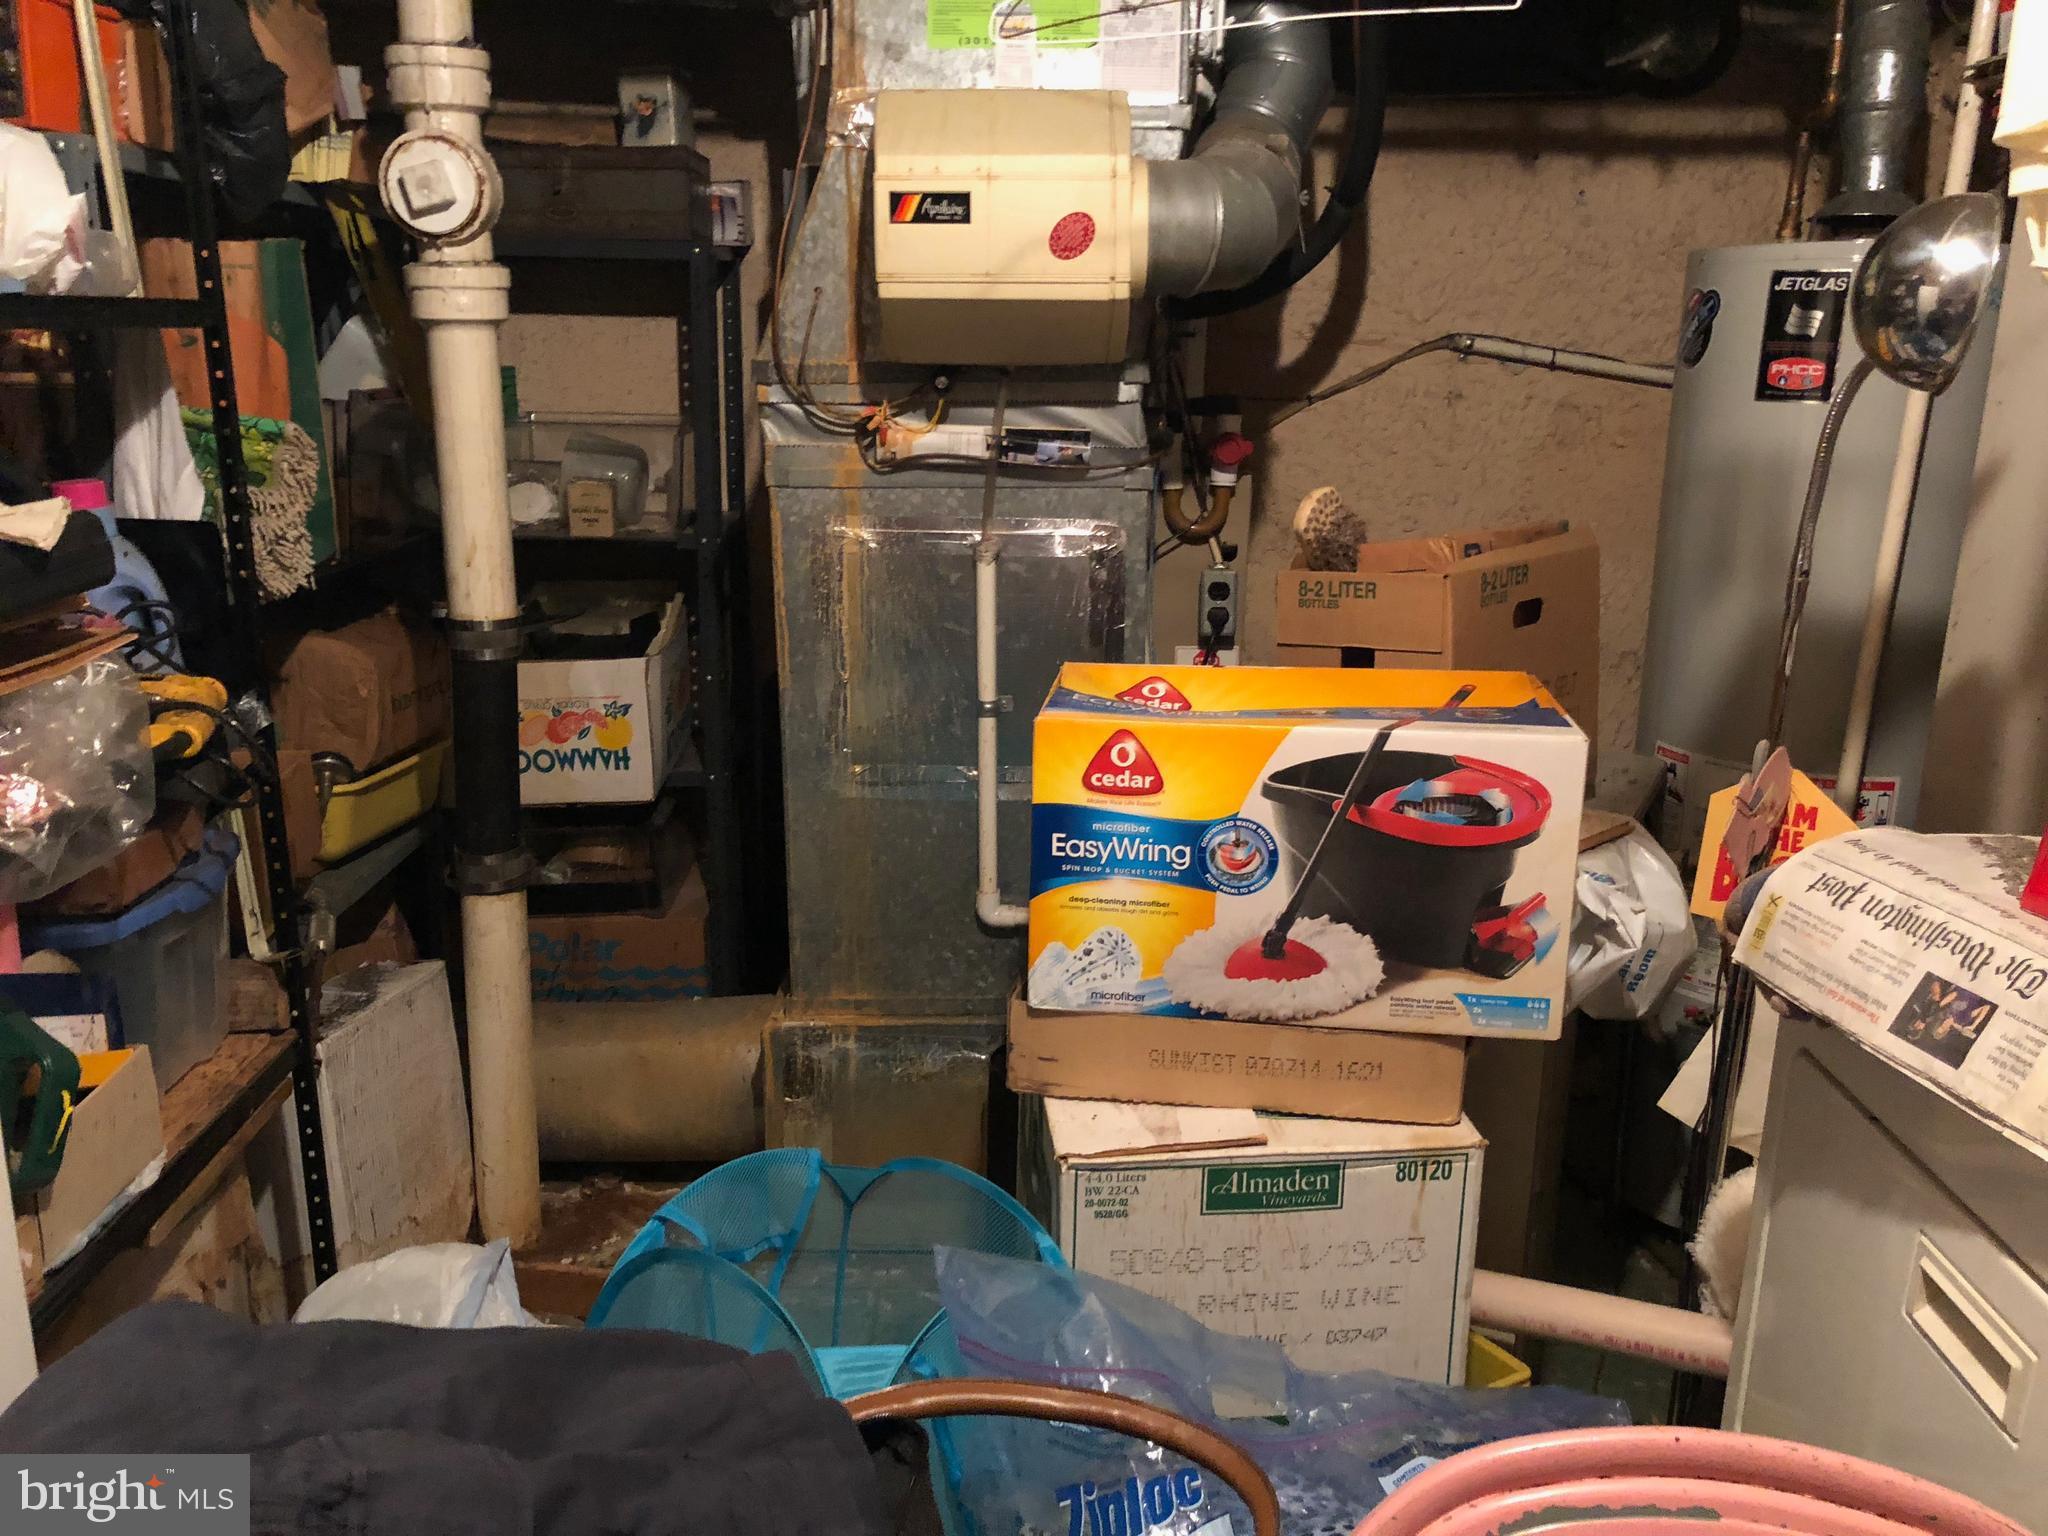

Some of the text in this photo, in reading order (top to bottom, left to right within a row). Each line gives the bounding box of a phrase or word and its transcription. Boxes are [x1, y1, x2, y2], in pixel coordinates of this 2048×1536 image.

[1774, 277, 1848, 292] JETGLAS
[1772, 364, 1825, 376] PHCC
[1480, 563, 1530, 594] 8-2 LITER
[1298, 580, 1377, 599] 8-2 LITER
[1297, 597, 1340, 609] BOTTLES
[1122, 695, 1184, 711] cedar
[1110, 742, 1137, 767] O
[1090, 769, 1155, 789] cedar
[1092, 822, 1151, 833] microfiber
[1200, 820, 1235, 848] CONTROLLED
[1235, 820, 1257, 830] WATER
[1051, 832, 1191, 870] EasyWring
[1805, 871, 1869, 911] Post
[1068, 896, 1170, 908] deep-cleaning microfiber
[1860, 894, 1995, 982] Washington
[1994, 956, 2048, 1000] The
[1090, 990, 1146, 1002] microfiber
[1149, 1049, 1237, 1075] SUNKIST
[1117, 1172, 1147, 1183] Liters
[1396, 1160, 1452, 1182] 80120
[1085, 1186, 1104, 1197] BW
[1212, 1170, 1330, 1195] Almaden
[1262, 1191, 1327, 1208] Vineyards
[1198, 1285, 1403, 1313] RHINE WINE
